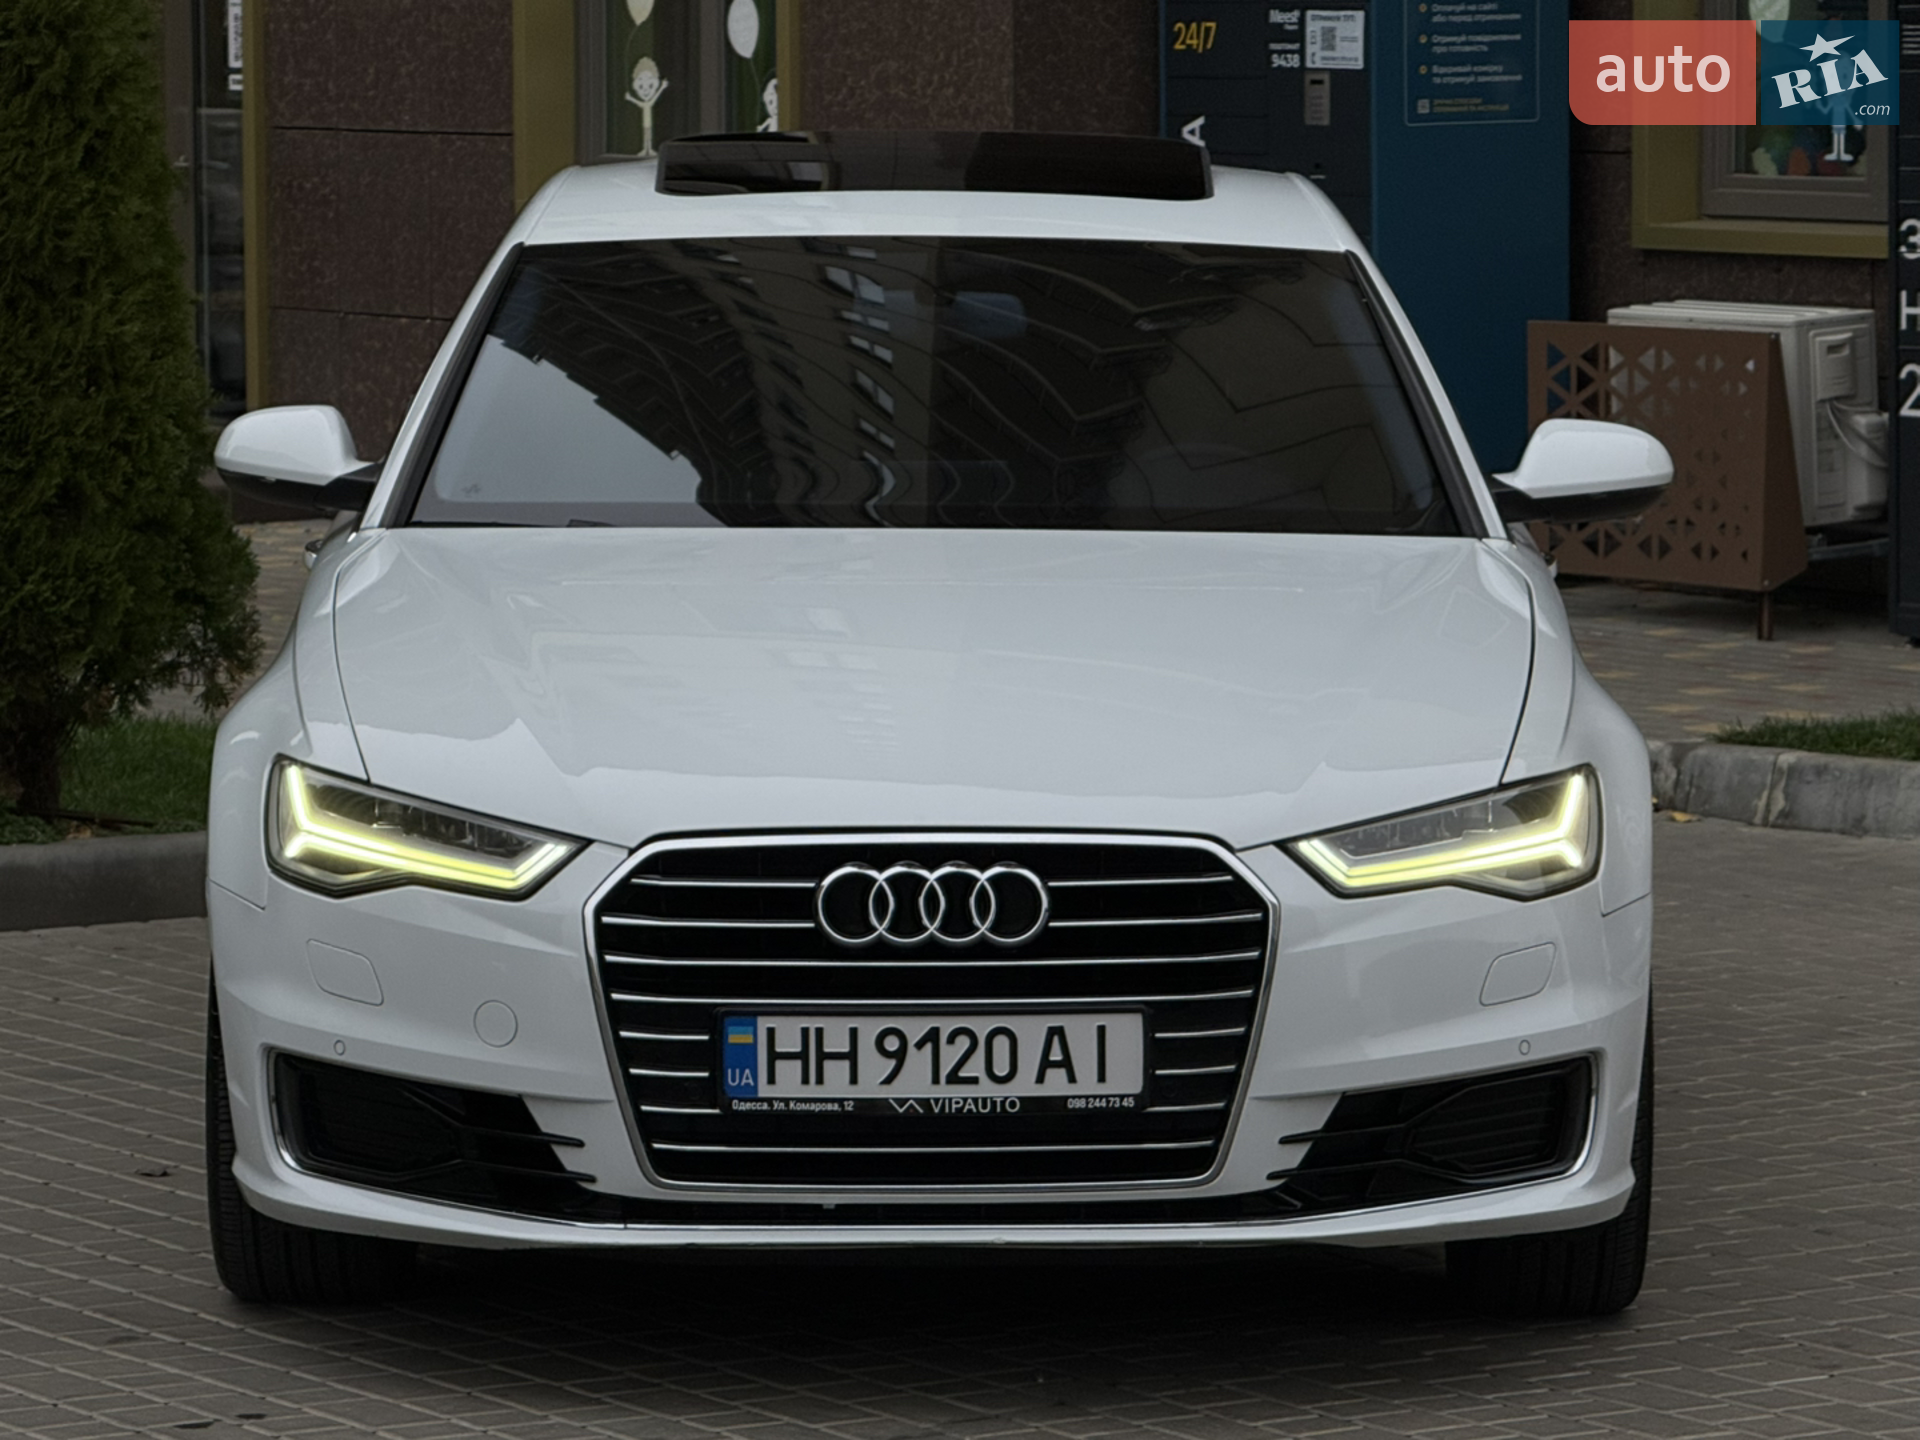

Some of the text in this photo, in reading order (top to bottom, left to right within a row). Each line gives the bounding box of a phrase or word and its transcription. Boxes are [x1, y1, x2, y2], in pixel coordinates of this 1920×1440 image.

[1173, 21, 1217, 53] 24/7
[1271, 54, 1300, 68] 9438
[766, 1025, 858, 1086] HH
[874, 1025, 1018, 1086] 9120
[727, 1068, 754, 1087] UA
[732, 1099, 854, 1112] Одесса. Ул. Комарова, 12
[930, 1097, 1020, 1113] VIPAUTO
[1067, 1096, 1135, 1109] 098 244 73 45
